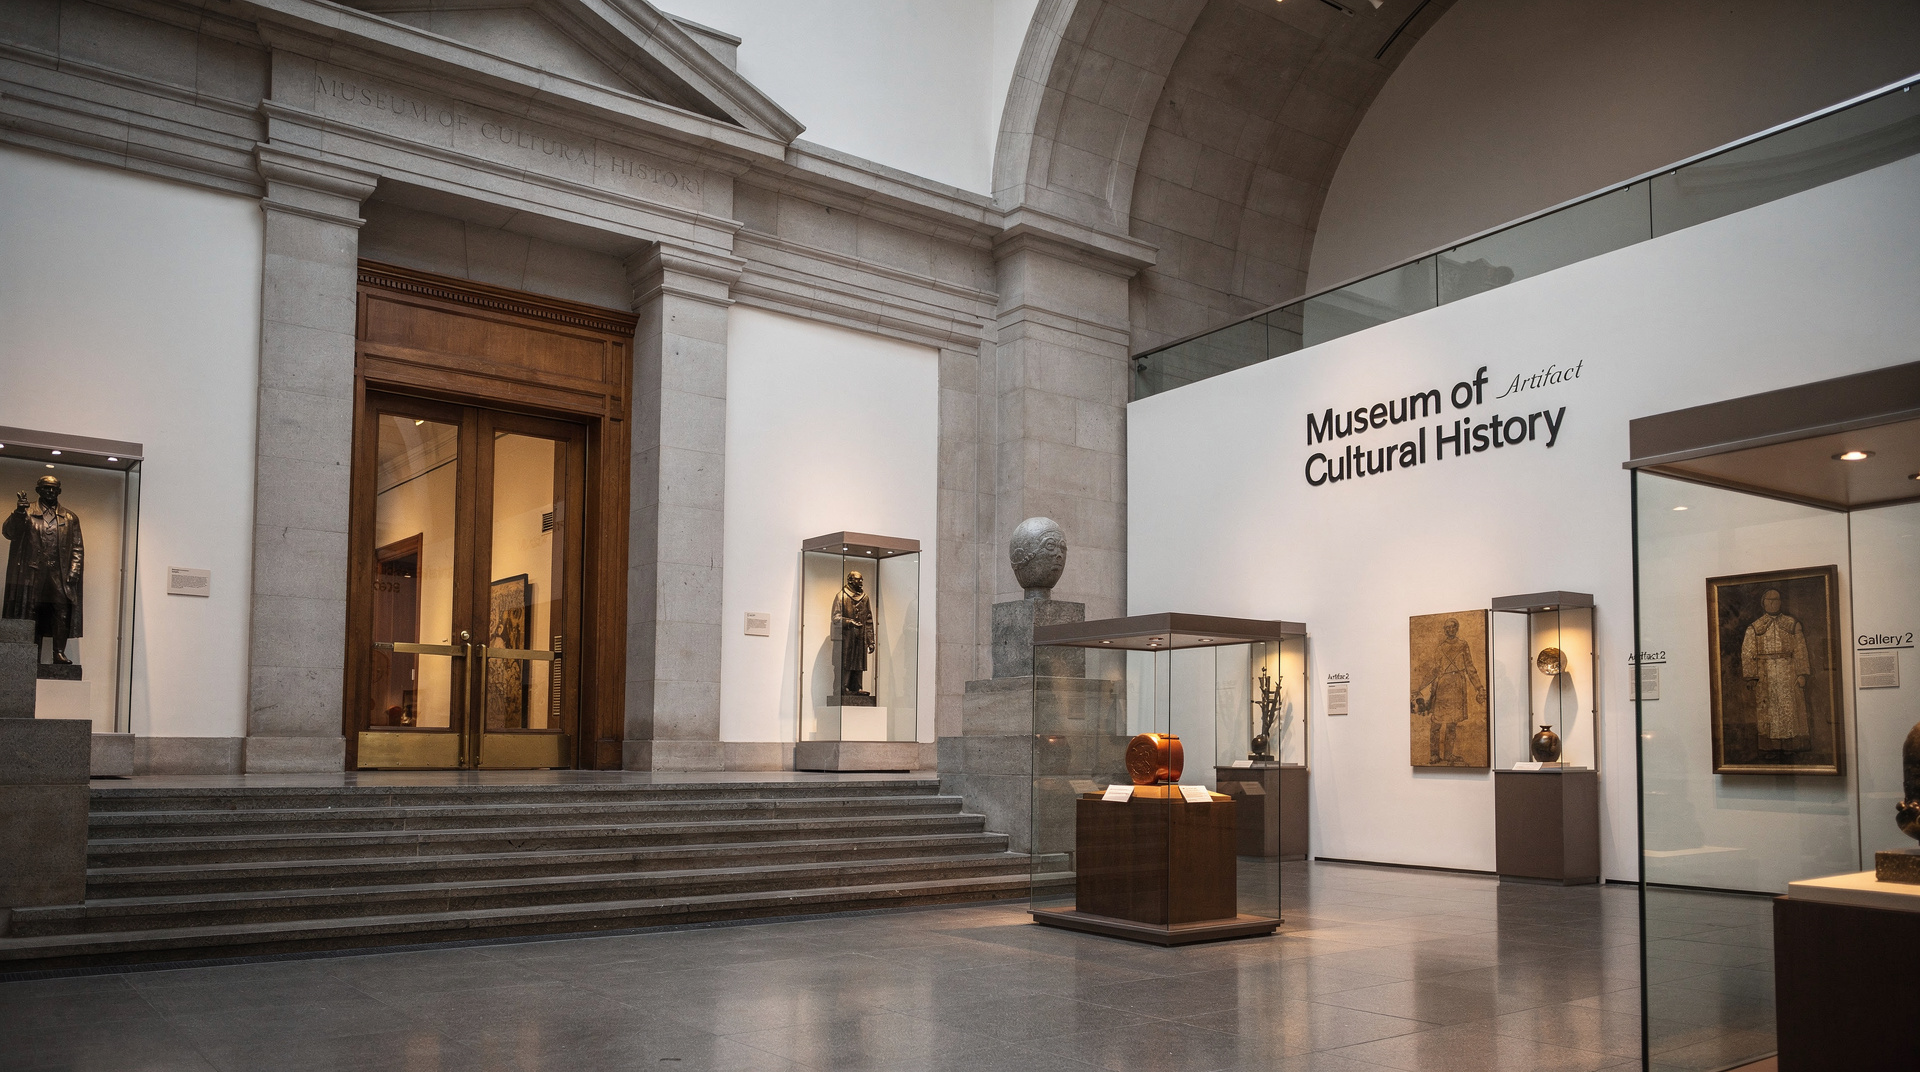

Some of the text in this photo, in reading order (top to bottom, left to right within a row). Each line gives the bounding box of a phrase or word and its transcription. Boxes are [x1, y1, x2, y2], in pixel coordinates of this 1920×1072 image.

[316, 75, 428, 123] MUSEUM
[438, 110, 469, 131] OF
[481, 122, 601, 170] CULTURAL
[1306, 366, 1489, 446] Museum of
[1496, 359, 1583, 400] Artifact
[1304, 406, 1567, 487] Cultural History
[1858, 632, 1914, 646] Gallery 2
